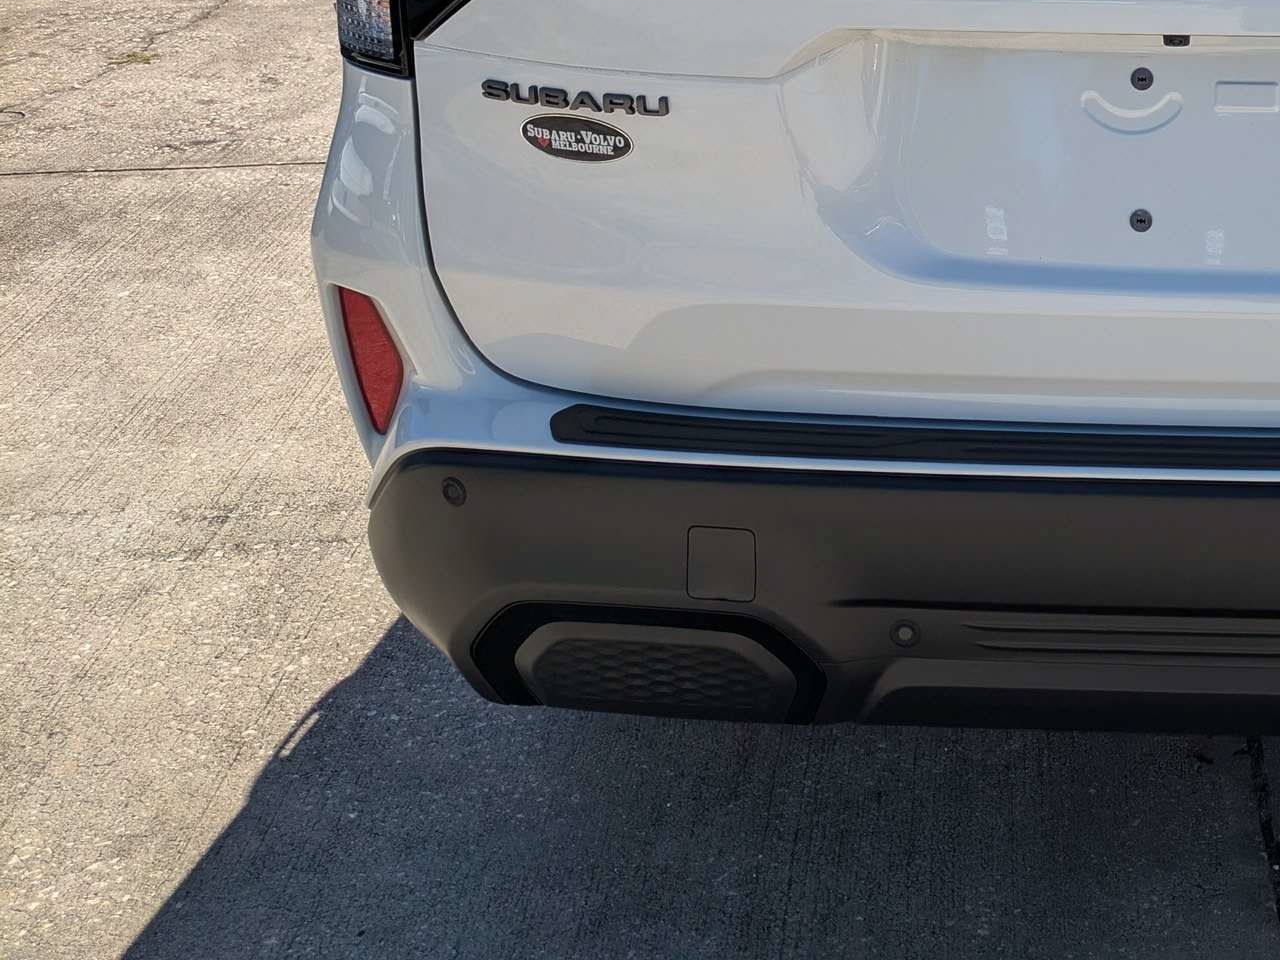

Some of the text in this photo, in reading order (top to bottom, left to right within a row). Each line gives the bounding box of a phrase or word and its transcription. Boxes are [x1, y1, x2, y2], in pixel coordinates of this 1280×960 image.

[481, 79, 669, 116] SUBARU
[526, 124, 625, 148] SUBARU VOLVO
[551, 140, 614, 155] MELBOURNE
